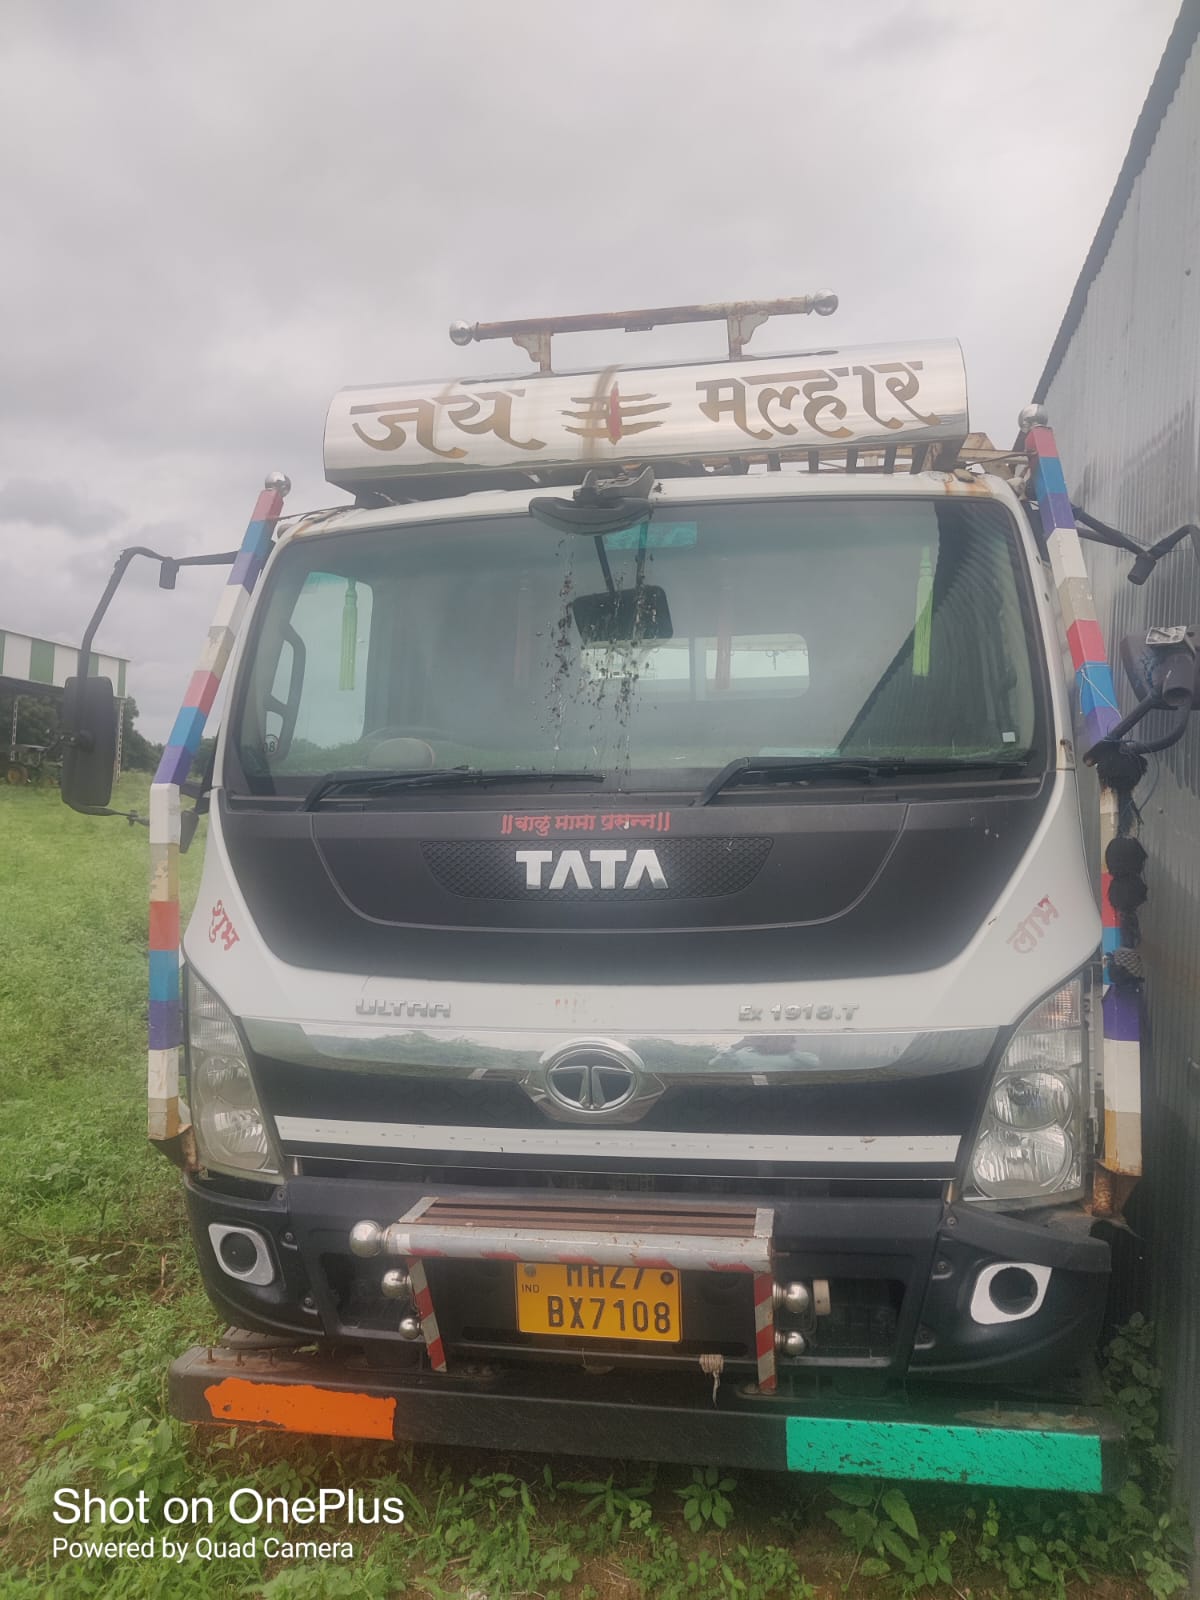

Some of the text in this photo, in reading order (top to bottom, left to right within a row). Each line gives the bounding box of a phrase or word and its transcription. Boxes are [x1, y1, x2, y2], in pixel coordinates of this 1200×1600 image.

[350, 361, 942, 459] जय मल्हार
[554, 814, 596, 831] मामा
[515, 849, 669, 890] TATA
[355, 999, 451, 1018] ULTRA
[521, 1284, 540, 1294] IND
[547, 1295, 671, 1334] BX7108
